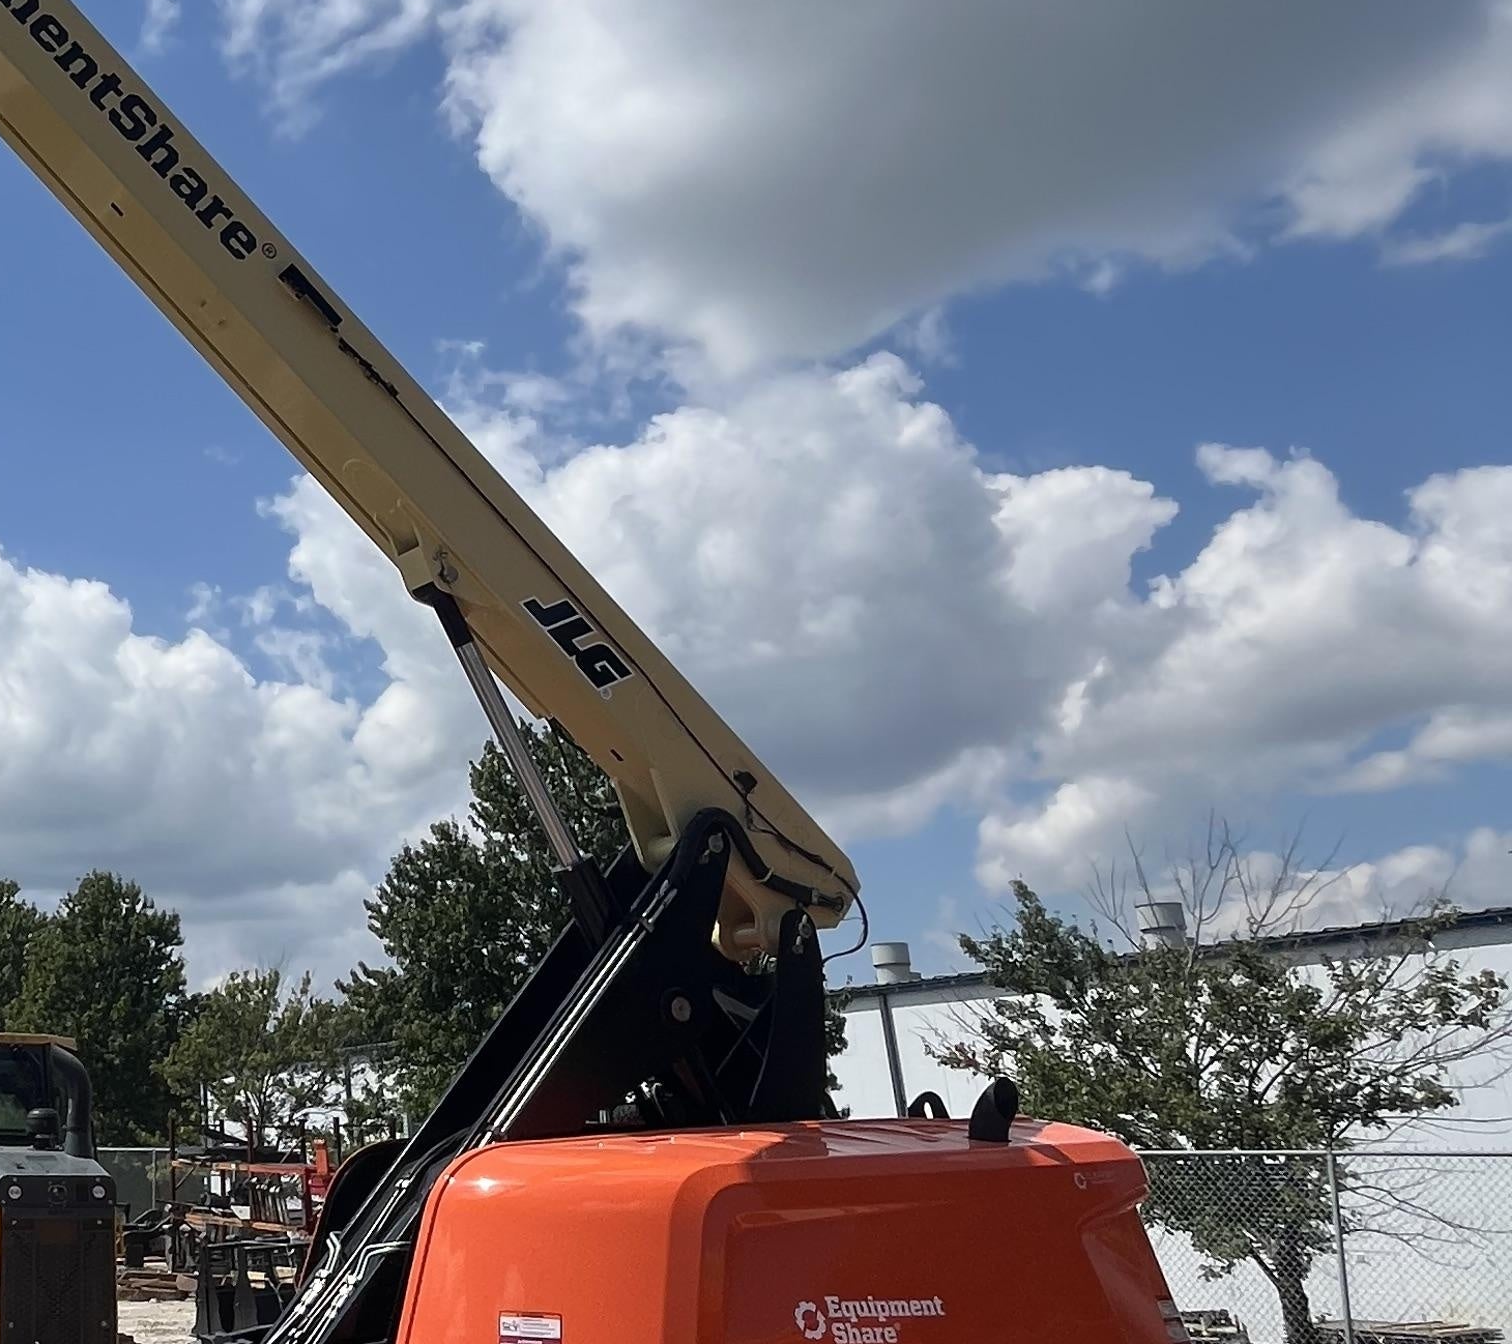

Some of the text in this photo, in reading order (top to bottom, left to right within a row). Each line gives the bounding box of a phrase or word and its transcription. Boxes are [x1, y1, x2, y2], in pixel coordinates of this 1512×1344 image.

[519, 596, 633, 691] JLG
[824, 1295, 946, 1322] Equipment
[831, 1322, 898, 1344] Share
